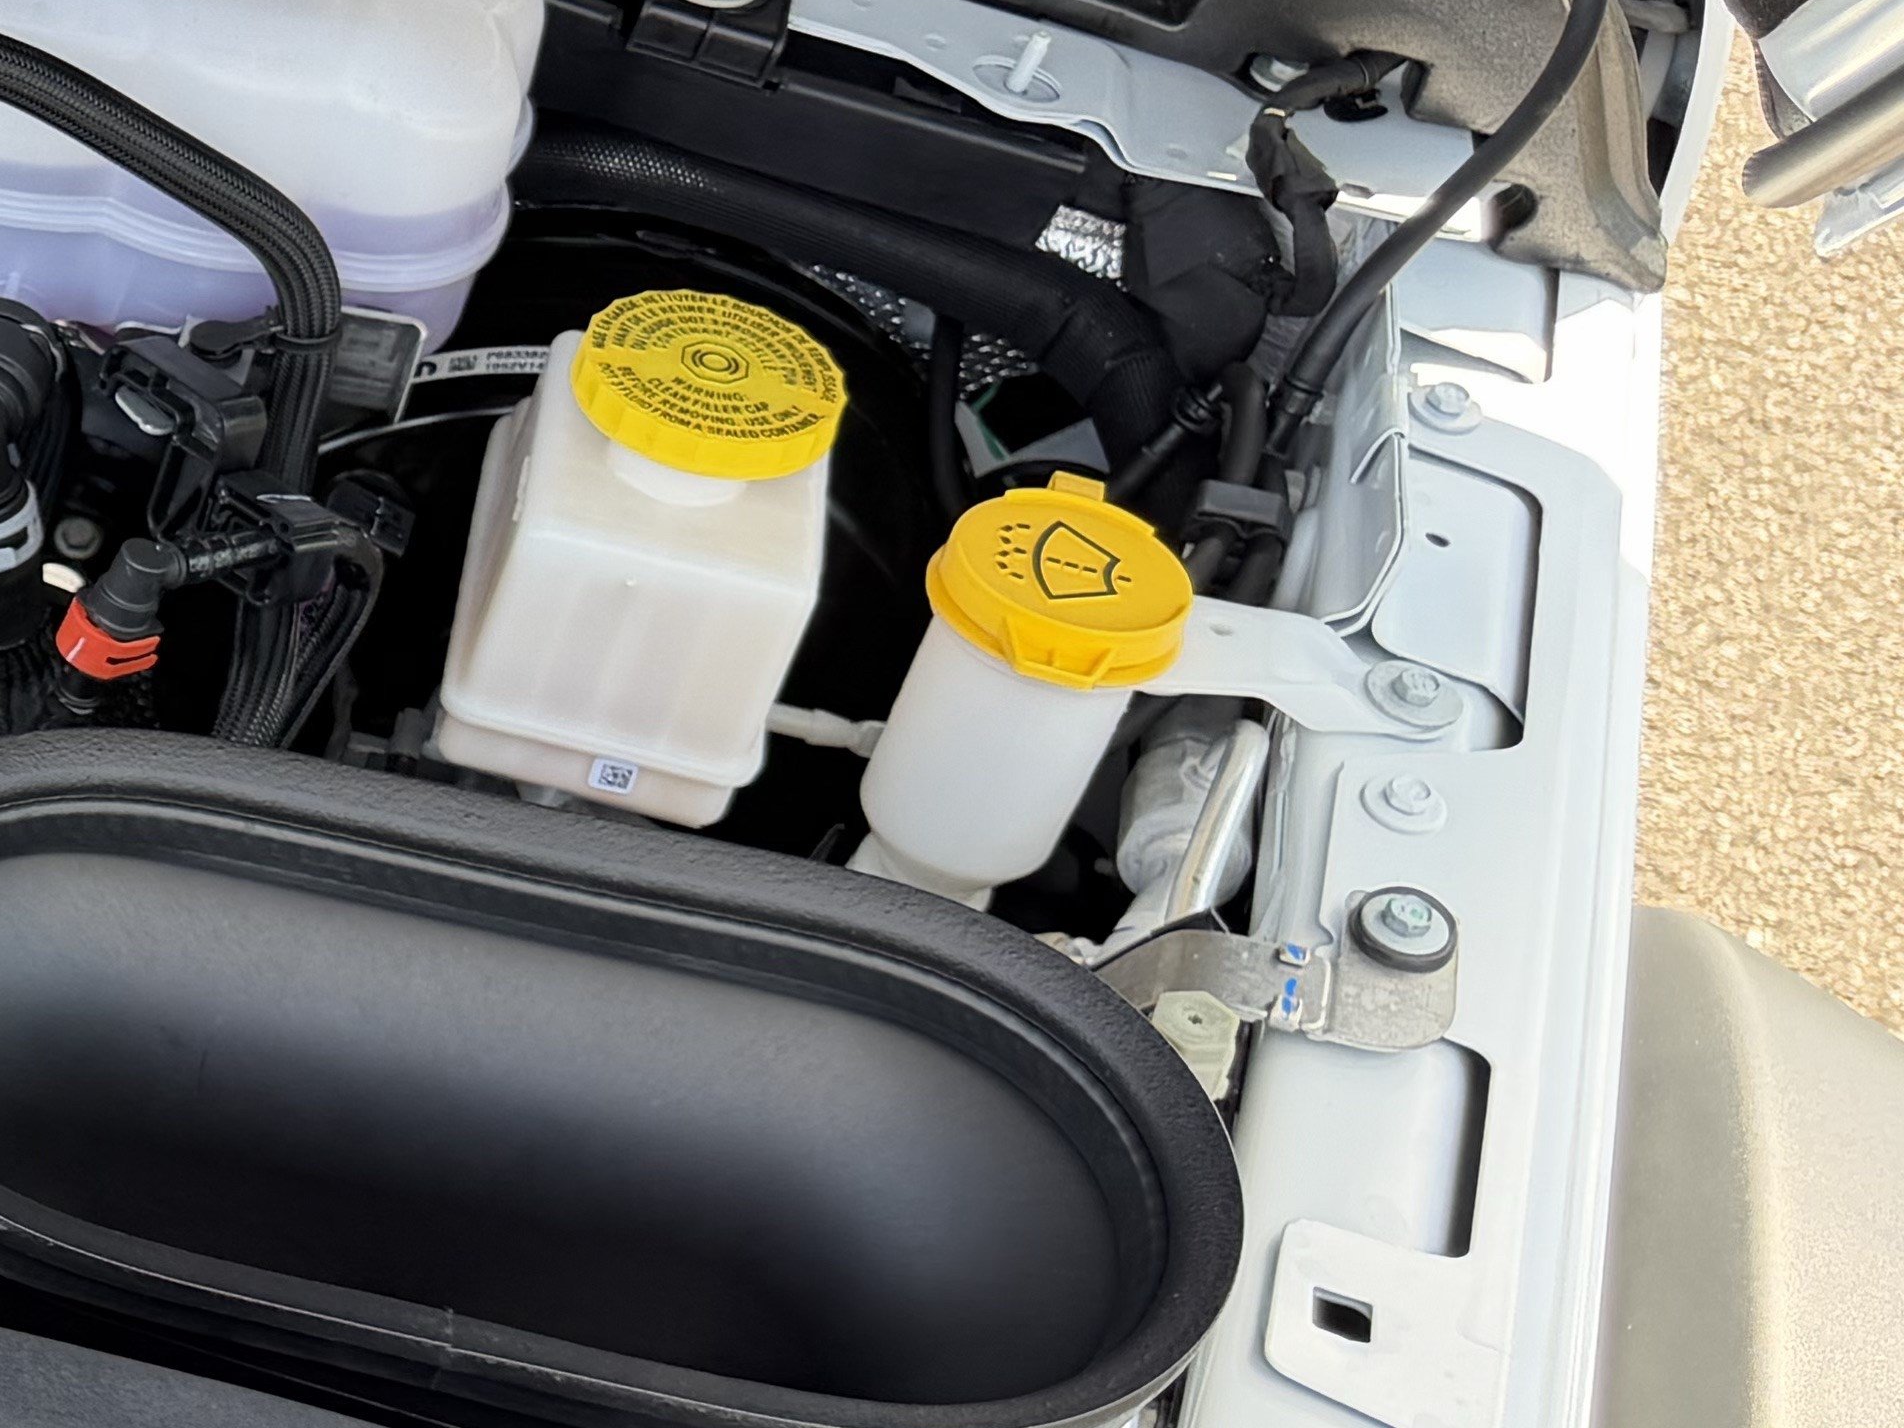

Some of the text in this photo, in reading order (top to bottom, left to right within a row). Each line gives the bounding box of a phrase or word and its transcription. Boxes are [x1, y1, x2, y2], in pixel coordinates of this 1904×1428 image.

[647, 377, 769, 414] CLEAN FILLER CAP
